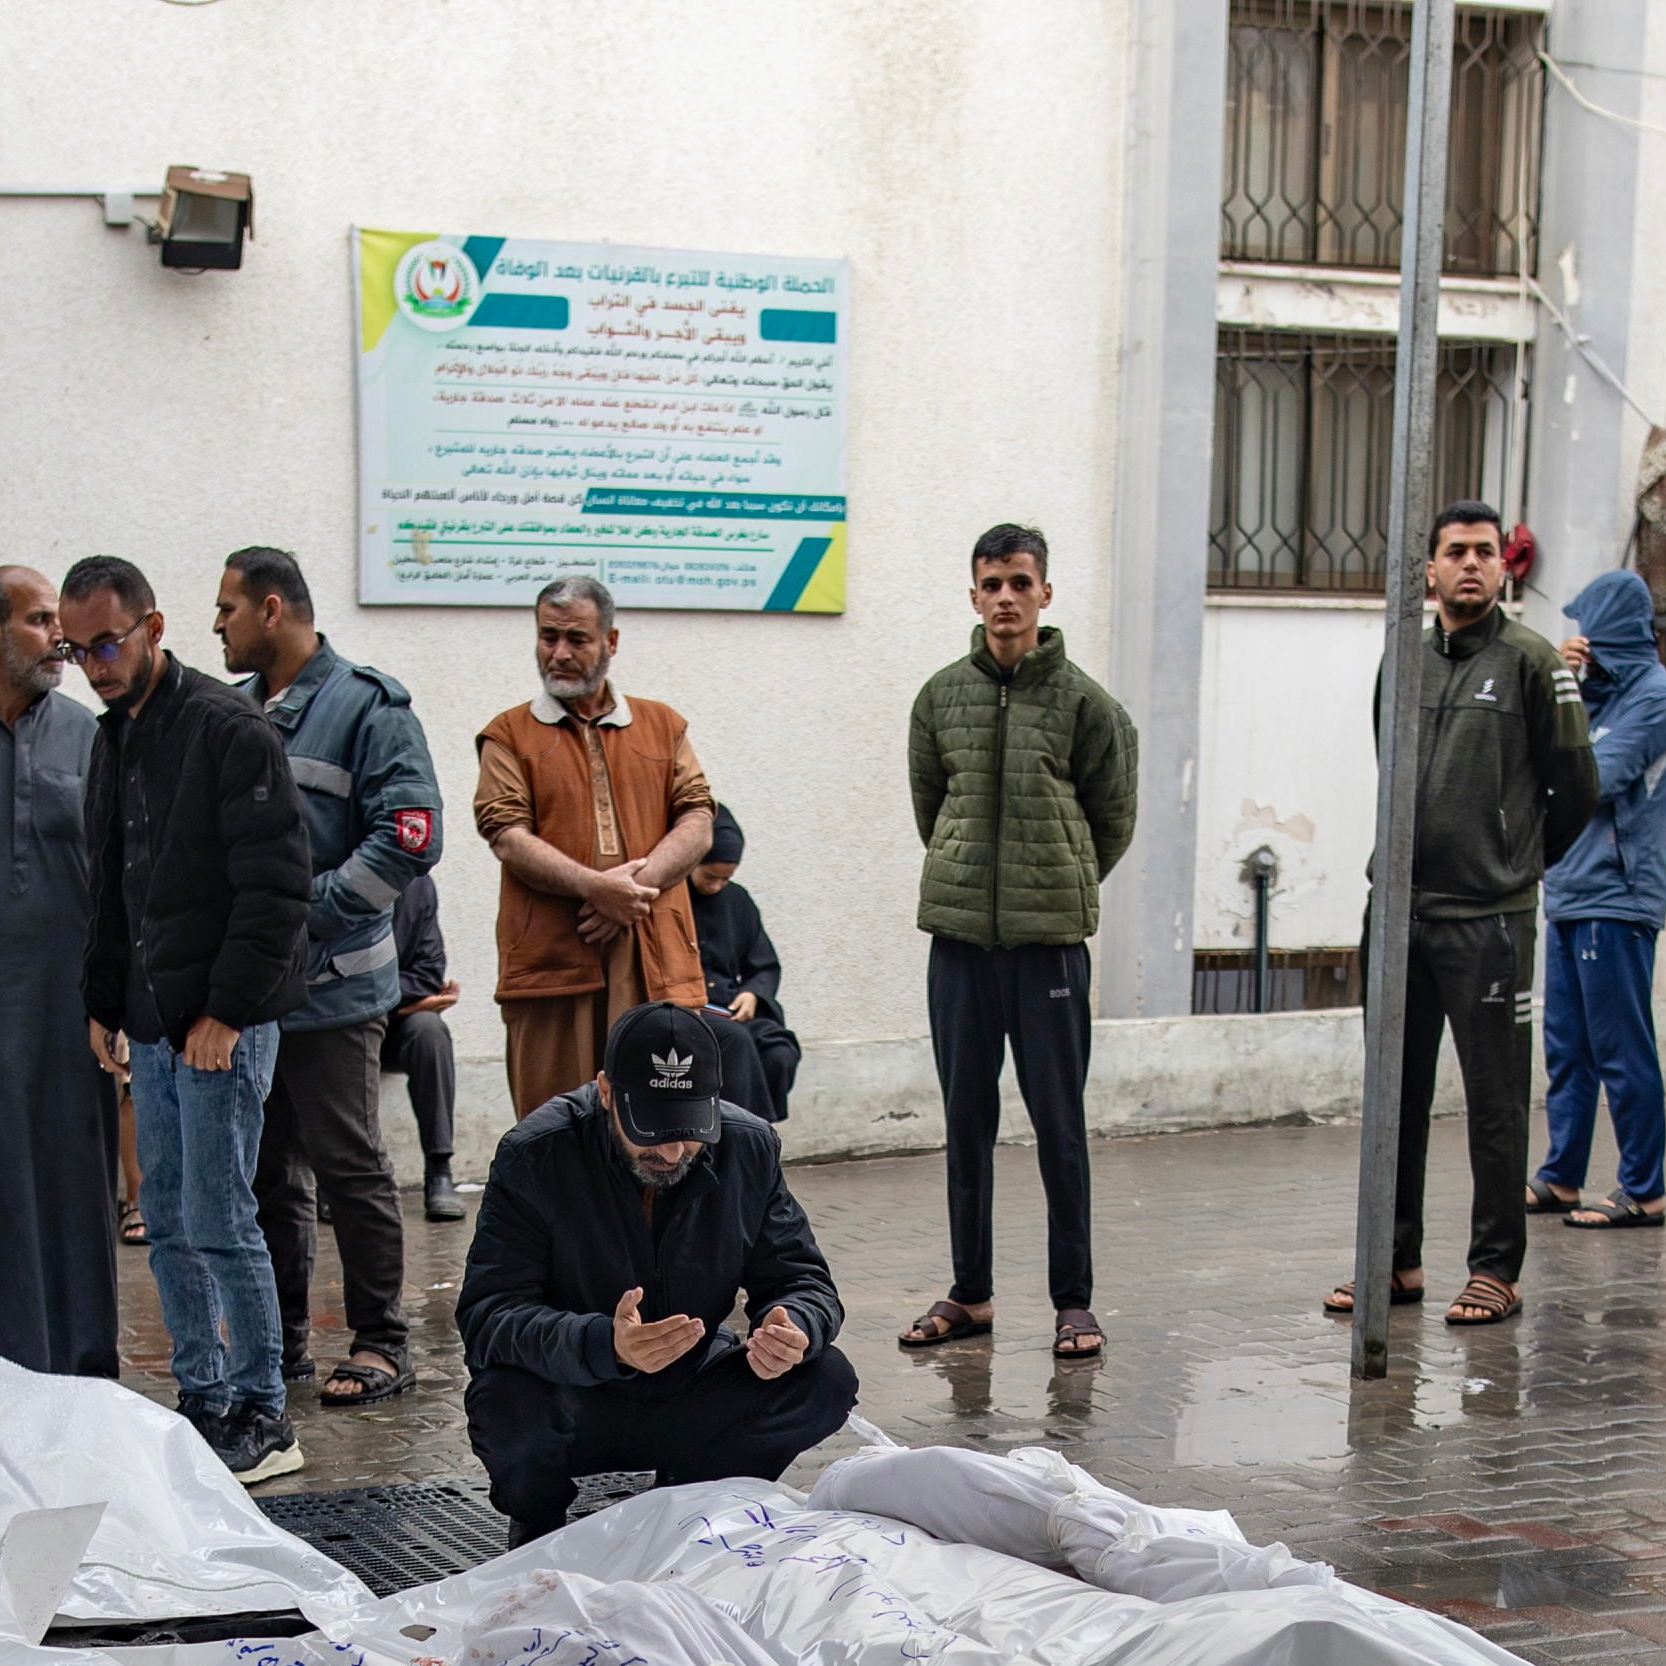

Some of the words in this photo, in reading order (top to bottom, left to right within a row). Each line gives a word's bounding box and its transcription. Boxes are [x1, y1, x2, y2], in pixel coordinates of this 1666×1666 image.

[496, 258, 550, 281] الوفاة
[554, 264, 582, 283] بعد
[587, 264, 661, 287] بالقرنيات
[665, 269, 711, 290] للتبرع
[715, 270, 777, 295] الوطنية
[782, 275, 836, 294] الحملة
[634, 296, 657, 317] في
[662, 299, 706, 316] الجسد
[708, 299, 747, 319] يفنى
[701, 328, 748, 346] ويبقى
[604, 345, 622, 357] الله
[730, 352, 746, 364] الله
[686, 354, 700, 367] في
[787, 357, 814, 369] الكريم
[761, 400, 781, 415] الله
[508, 413, 537, 428] مسلم
[494, 460, 517, 475] الله
[381, 487, 412, 502] الحياة
[649, 1077, 693, 1090] adidas
